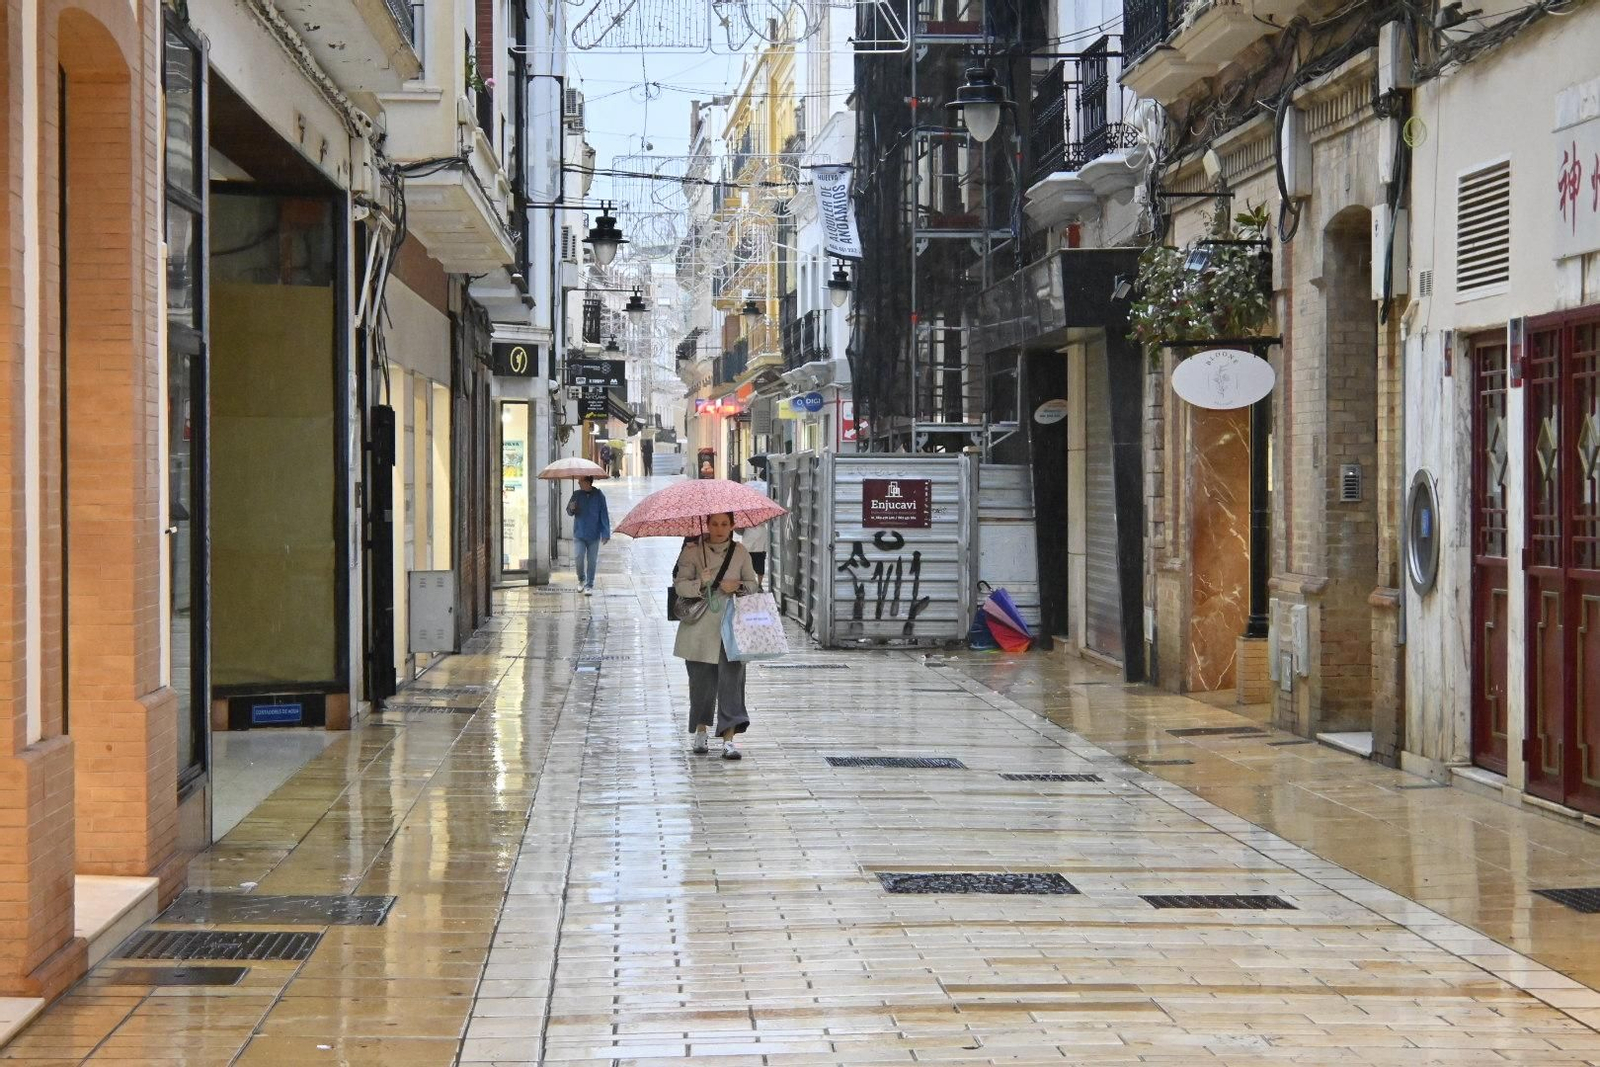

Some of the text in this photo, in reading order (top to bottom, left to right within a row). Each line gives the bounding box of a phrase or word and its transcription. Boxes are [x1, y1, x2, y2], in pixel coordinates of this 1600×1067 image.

[821, 186, 839, 242] ALQUILER DE
[832, 184, 852, 244] ANDAMIOS
[870, 499, 917, 512] Enjucavi
